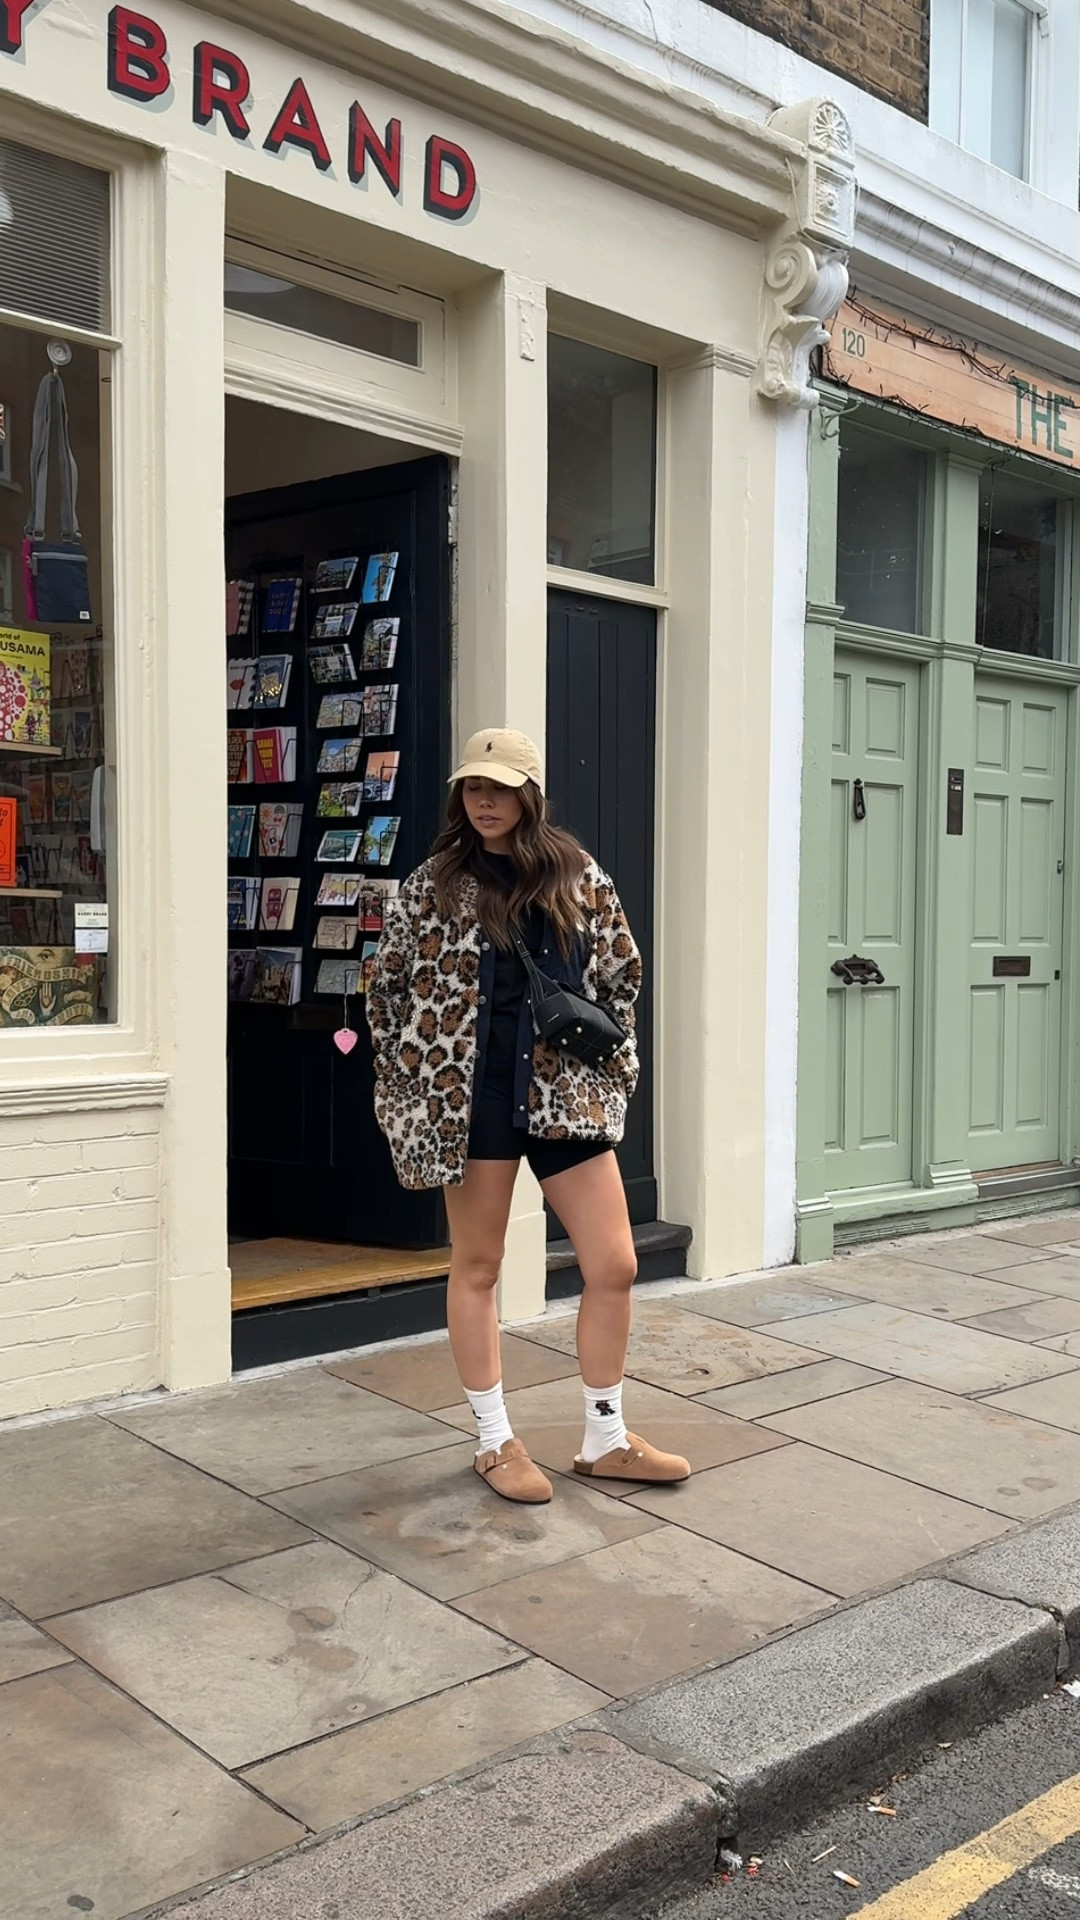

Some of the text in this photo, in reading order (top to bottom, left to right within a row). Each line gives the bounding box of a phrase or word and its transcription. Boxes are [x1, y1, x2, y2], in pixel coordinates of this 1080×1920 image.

[107, 4, 478, 221] BRAND
[842, 327, 865, 358] 120
[1009, 376, 1073, 458] THE
[0, 641, 46, 657] USAMA
[6, 956, 84, 980] FRIENDSHIP
